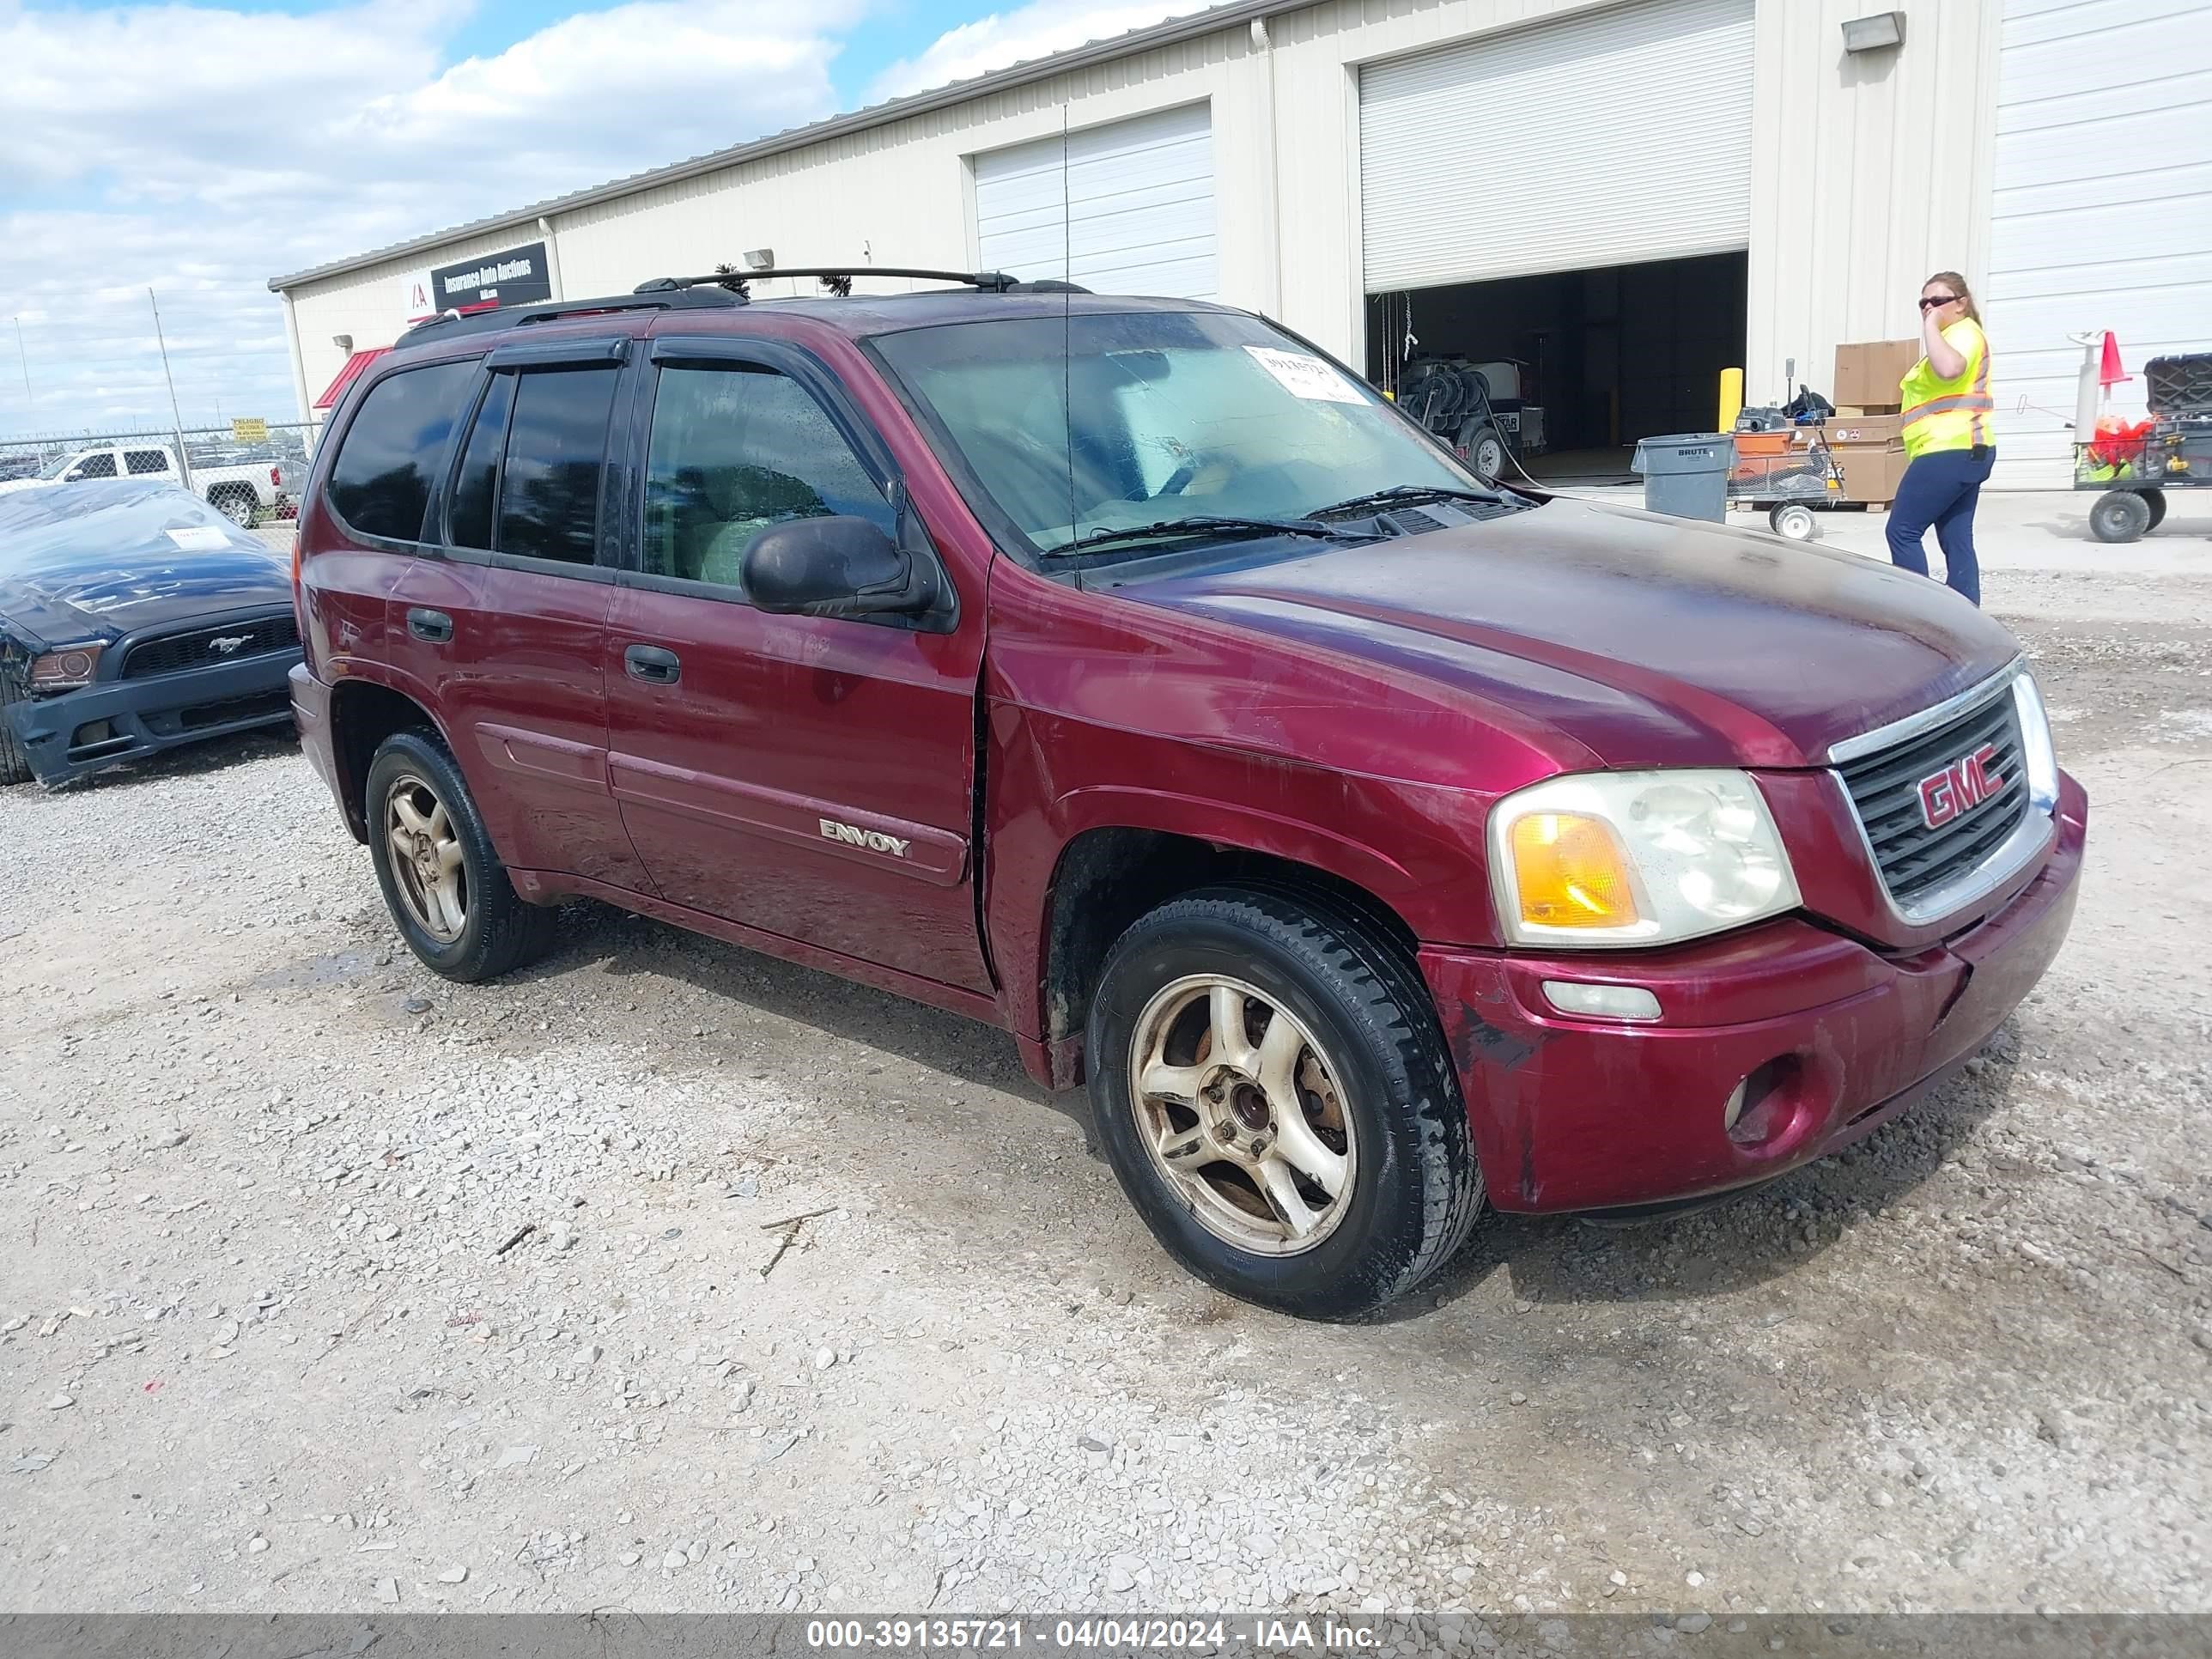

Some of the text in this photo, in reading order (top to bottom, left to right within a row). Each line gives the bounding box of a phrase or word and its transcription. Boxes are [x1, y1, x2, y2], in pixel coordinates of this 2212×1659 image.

[444, 258, 532, 294] Insurance Auto Auctions
[1916, 742, 2004, 830] GMC
[818, 818, 911, 857] ENVOY
